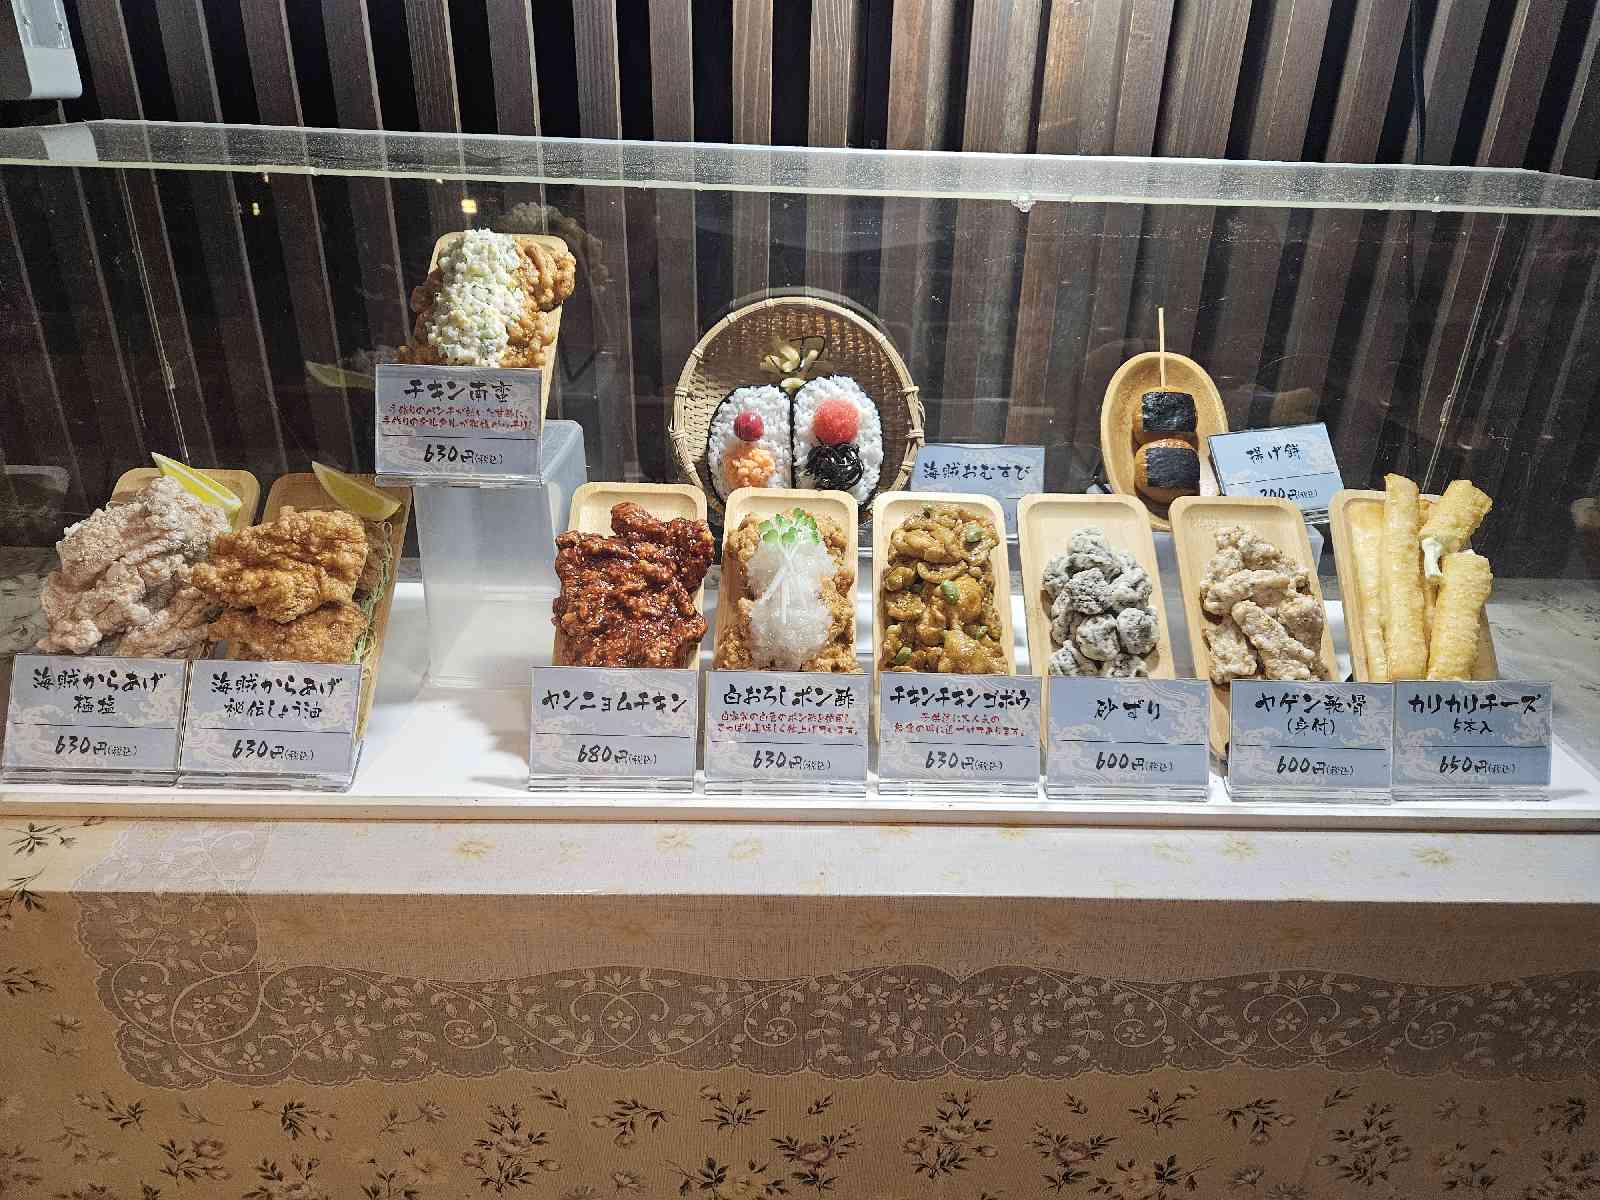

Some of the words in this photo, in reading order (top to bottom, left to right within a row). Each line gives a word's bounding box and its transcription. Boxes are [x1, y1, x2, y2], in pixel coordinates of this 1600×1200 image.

[404, 379, 512, 402] チキン南蛮
[1246, 443, 1301, 464] 揚げ餅
[923, 460, 1031, 480] 海賊おむすび
[32, 666, 166, 692] 海賊からあげ
[211, 671, 343, 697] 海賊からあげ
[74, 694, 116, 714] 極塩
[224, 698, 322, 719] 秘伝しょう油
[541, 689, 688, 714] ヤンニョムチキン
[889, 685, 1031, 710] チキンチキンゴボウ
[1255, 692, 1367, 717] ヤゲン軟骨
[1408, 693, 1542, 714] カリカリチーズ
[1094, 698, 1160, 720] 砂ずり
[1453, 718, 1493, 734] 5本入
